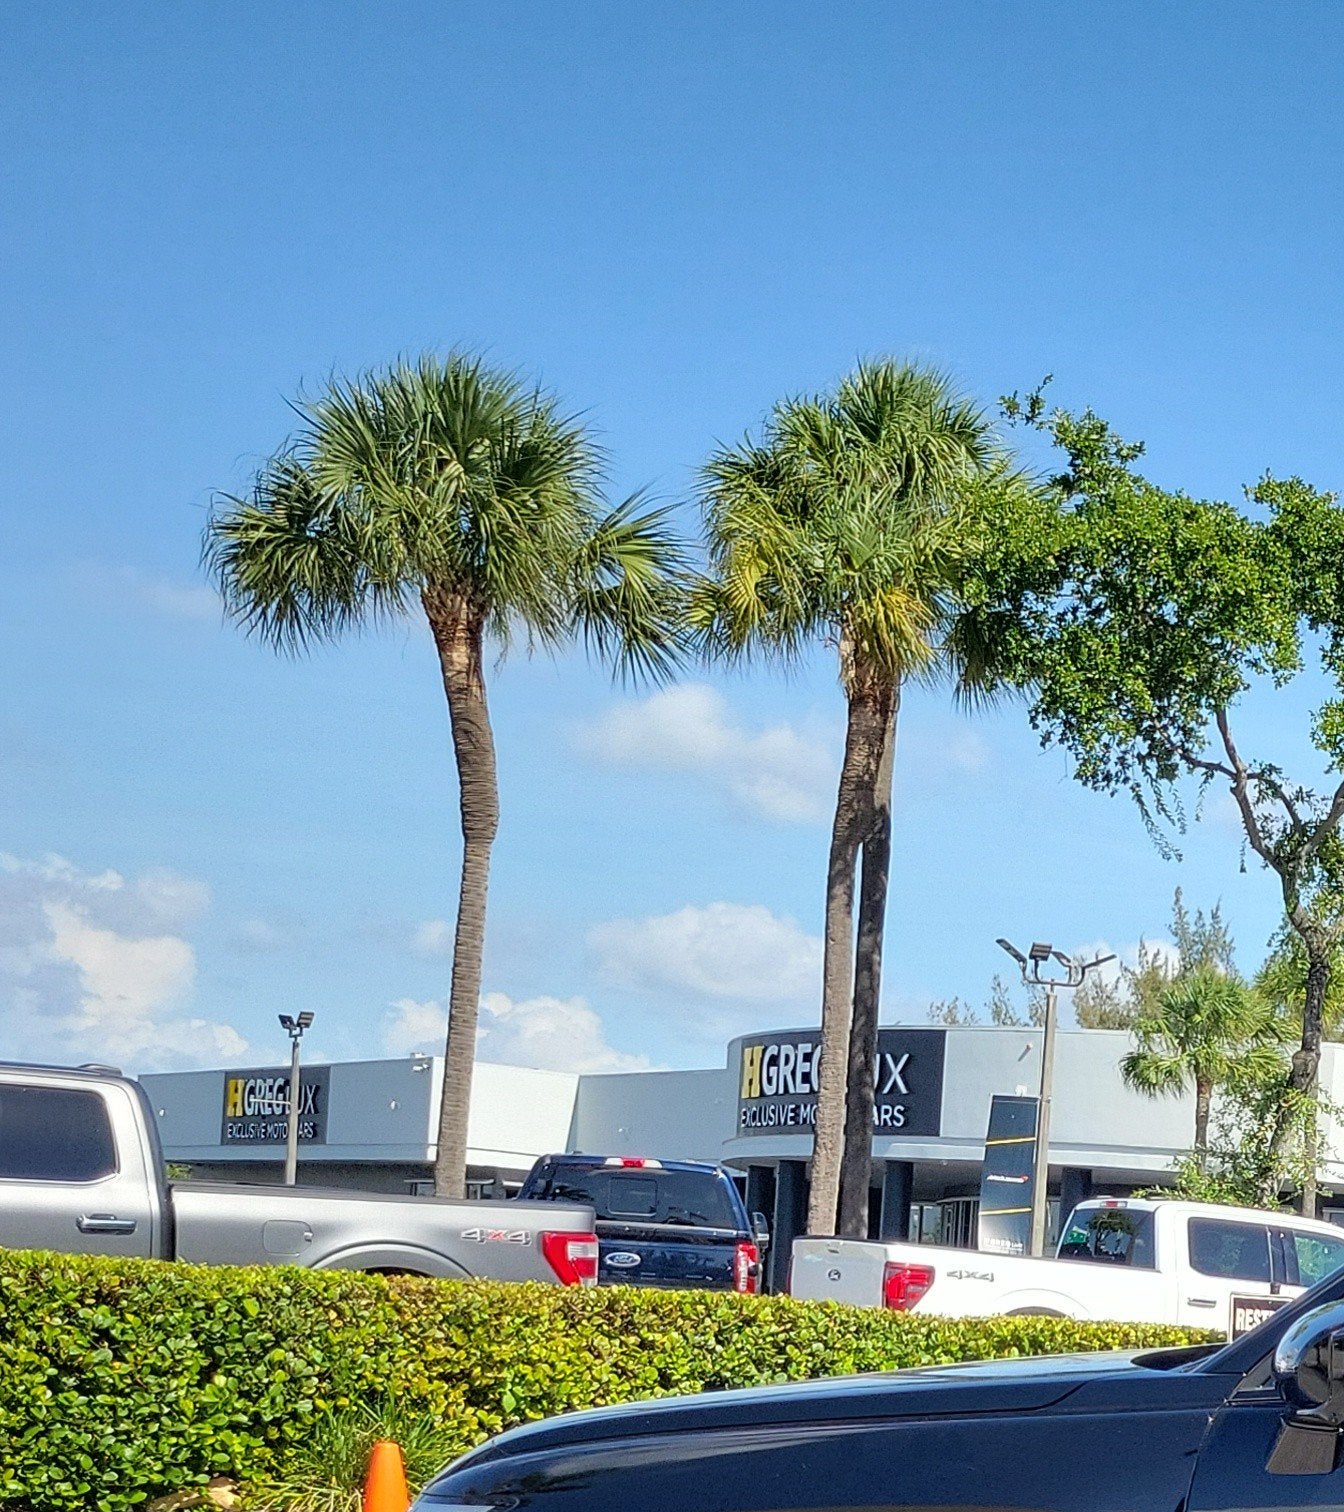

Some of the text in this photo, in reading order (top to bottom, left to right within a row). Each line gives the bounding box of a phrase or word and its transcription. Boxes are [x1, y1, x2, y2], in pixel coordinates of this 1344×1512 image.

[740, 1103, 796, 1128] EXCLUSIVE
[227, 1121, 314, 1139] EXCLUSIVE MOTOARS
[1235, 1308, 1277, 1332] REST
